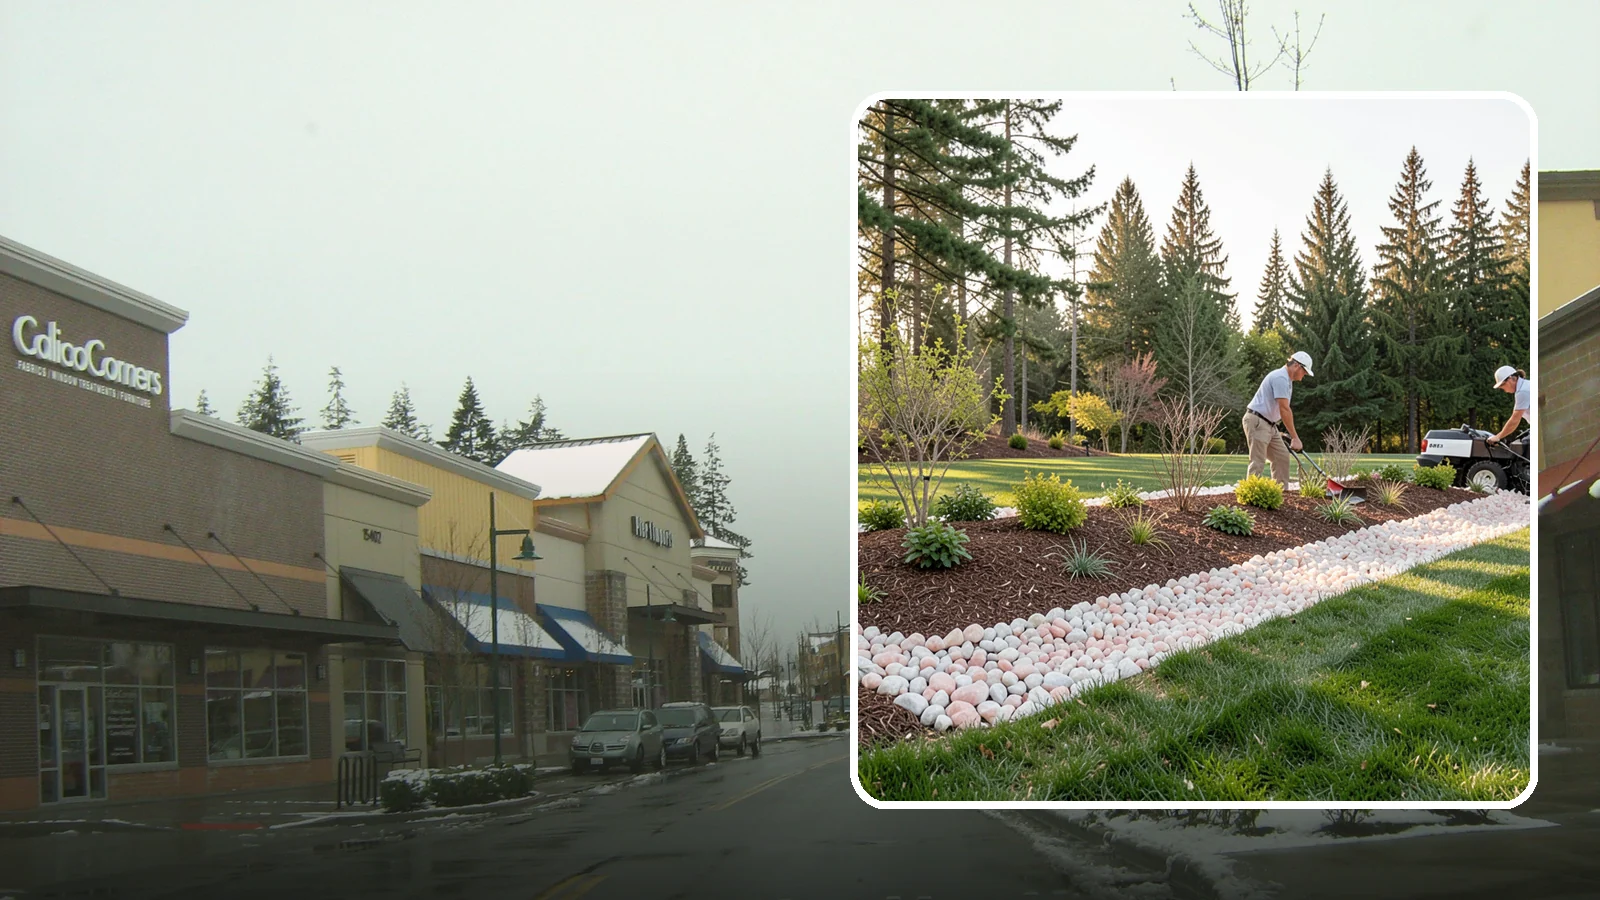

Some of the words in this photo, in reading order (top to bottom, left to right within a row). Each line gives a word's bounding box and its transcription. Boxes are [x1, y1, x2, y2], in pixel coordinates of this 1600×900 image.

[17, 360, 47, 377] FABRICS
[52, 370, 78, 386] WINDOW
[78, 378, 116, 398] TREATMENTS
[120, 391, 151, 408] FURNITURE
